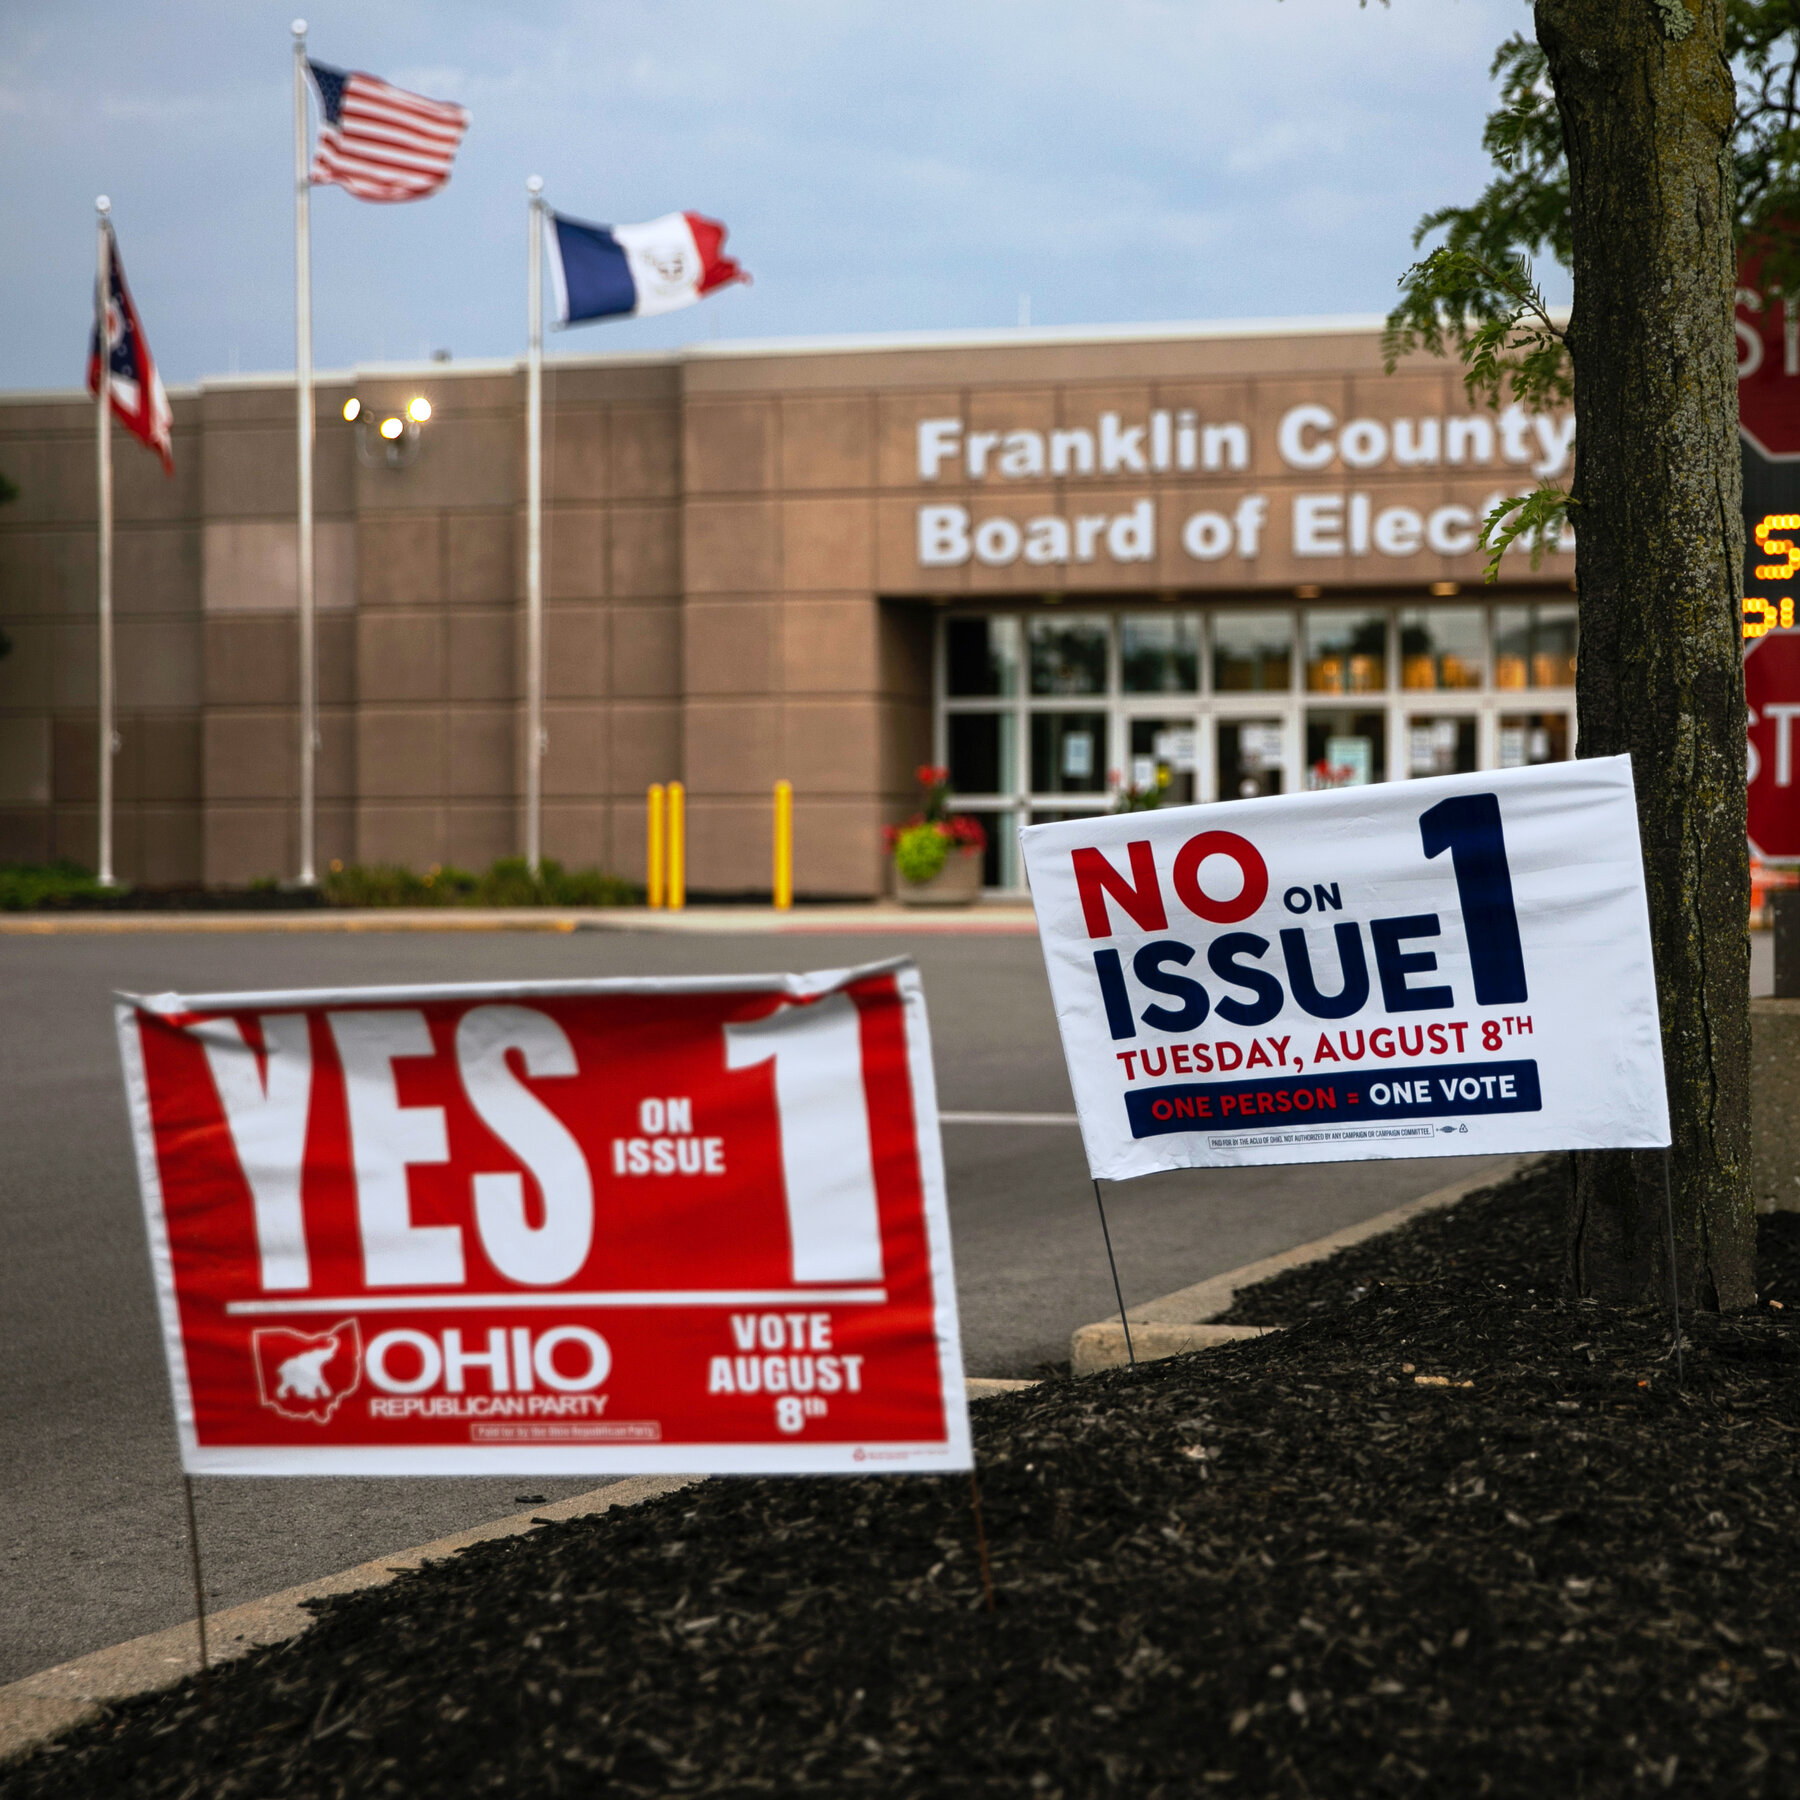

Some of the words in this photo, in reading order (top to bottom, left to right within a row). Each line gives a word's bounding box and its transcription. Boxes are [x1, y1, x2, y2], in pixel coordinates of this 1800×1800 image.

[917, 409, 1249, 481] Franklin
[1279, 403, 1576, 479] County
[917, 496, 1156, 568] Board
[1182, 494, 1269, 561] of
[1071, 830, 1268, 939] NO
[1283, 882, 1342, 914] ON
[1094, 913, 1454, 1040] ISSUE
[1419, 792, 1528, 1006] 1
[1117, 1036, 1304, 1081] TUESDAY,
[1313, 1021, 1469, 1064] AUGUST
[1481, 1015, 1534, 1052] 8TH
[640, 1097, 692, 1134] ON
[1151, 1095, 1212, 1121] ONE
[1221, 1087, 1337, 1117] PERSON
[1368, 1080, 1432, 1107] ONE
[1439, 1074, 1518, 1101] VOTE
[184, 1004, 594, 1290] YES
[613, 1137, 726, 1175] ISSUE
[722, 991, 885, 1283] 1
[1250, 1137, 1263, 1145] ACLU
[1295, 1133, 1324, 1142] AUTHORIZED
[1324, 1132, 1331, 1140] BY
[1332, 1131, 1341, 1139] ANY
[1342, 1130, 1367, 1139] CAMPAIGN
[1368, 1129, 1376, 1137] OR
[1376, 1128, 1401, 1137] CAMPAIGN
[1401, 1127, 1431, 1136] COMMITTEE.
[731, 1313, 833, 1350] VOTE
[365, 1326, 612, 1394] OHIO
[709, 1354, 864, 1394] AUGUST
[369, 1396, 524, 1419] REPUBLICAN
[529, 1394, 609, 1416] PARTY
[776, 1396, 828, 1434] 8th
